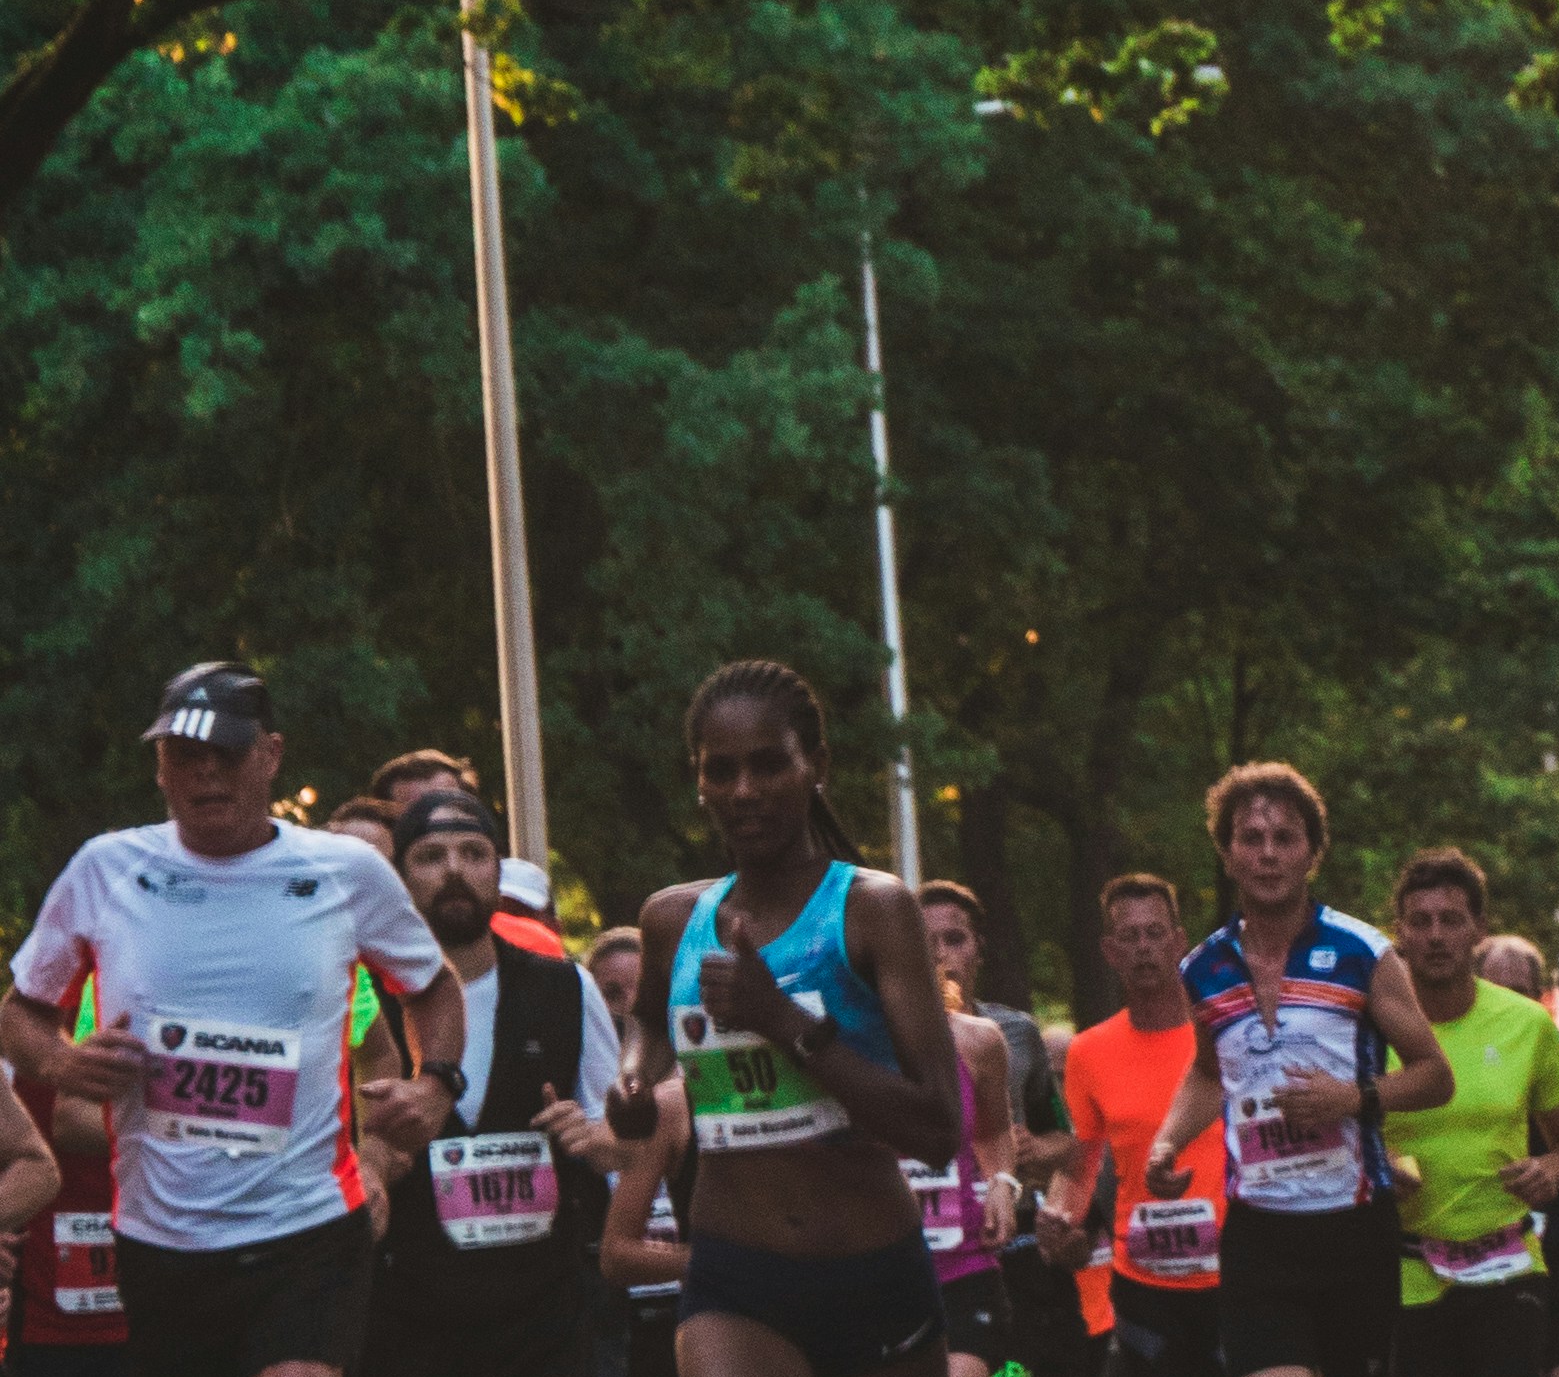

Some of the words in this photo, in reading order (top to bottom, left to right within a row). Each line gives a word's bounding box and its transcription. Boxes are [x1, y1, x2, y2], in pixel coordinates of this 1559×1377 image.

[193, 1032, 285, 1057] SCANIA
[174, 1060, 268, 1109] 2425
[726, 1048, 777, 1095] 50
